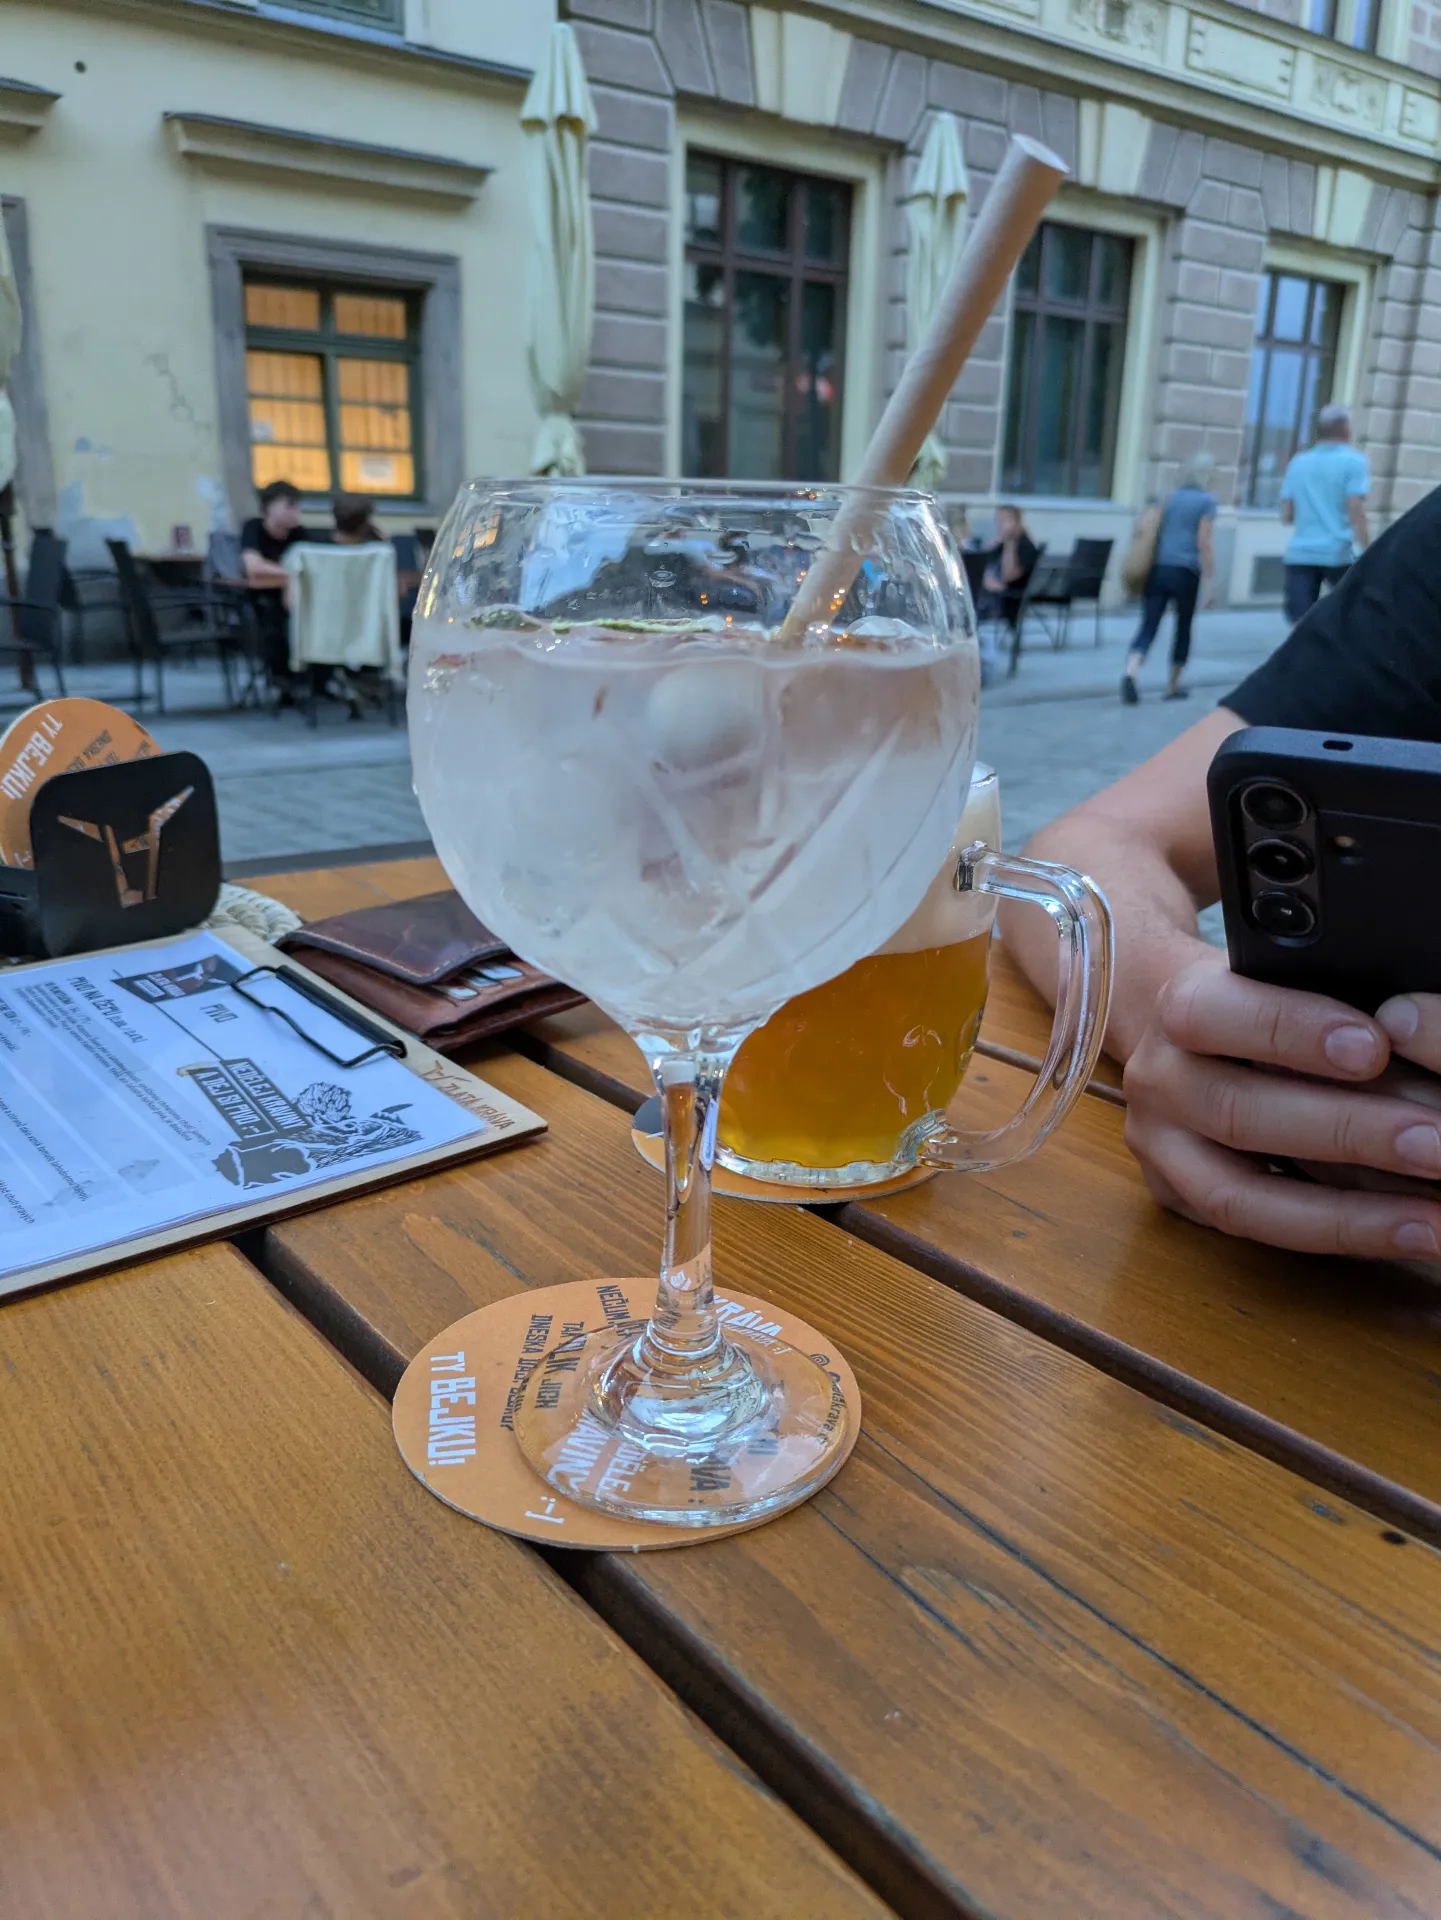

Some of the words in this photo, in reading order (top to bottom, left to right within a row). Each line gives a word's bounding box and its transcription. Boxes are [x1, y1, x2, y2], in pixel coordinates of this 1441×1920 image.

[41, 712, 64, 739] TY
[0, 730, 55, 799] BEJKU!
[200, 1003, 239, 1023] PIVO
[201, 1077, 236, 1096] DEJ
[216, 1094, 244, 1106] SI
[258, 1095, 308, 1129] KRAVINY
[223, 1103, 262, 1125] PIVO
[468, 1104, 516, 1130] KRÁVA
[521, 1314, 554, 1354] DNESKA
[430, 1351, 466, 1372] TY
[535, 1378, 563, 1409] JICH
[427, 1376, 477, 1466] BEJKU!
